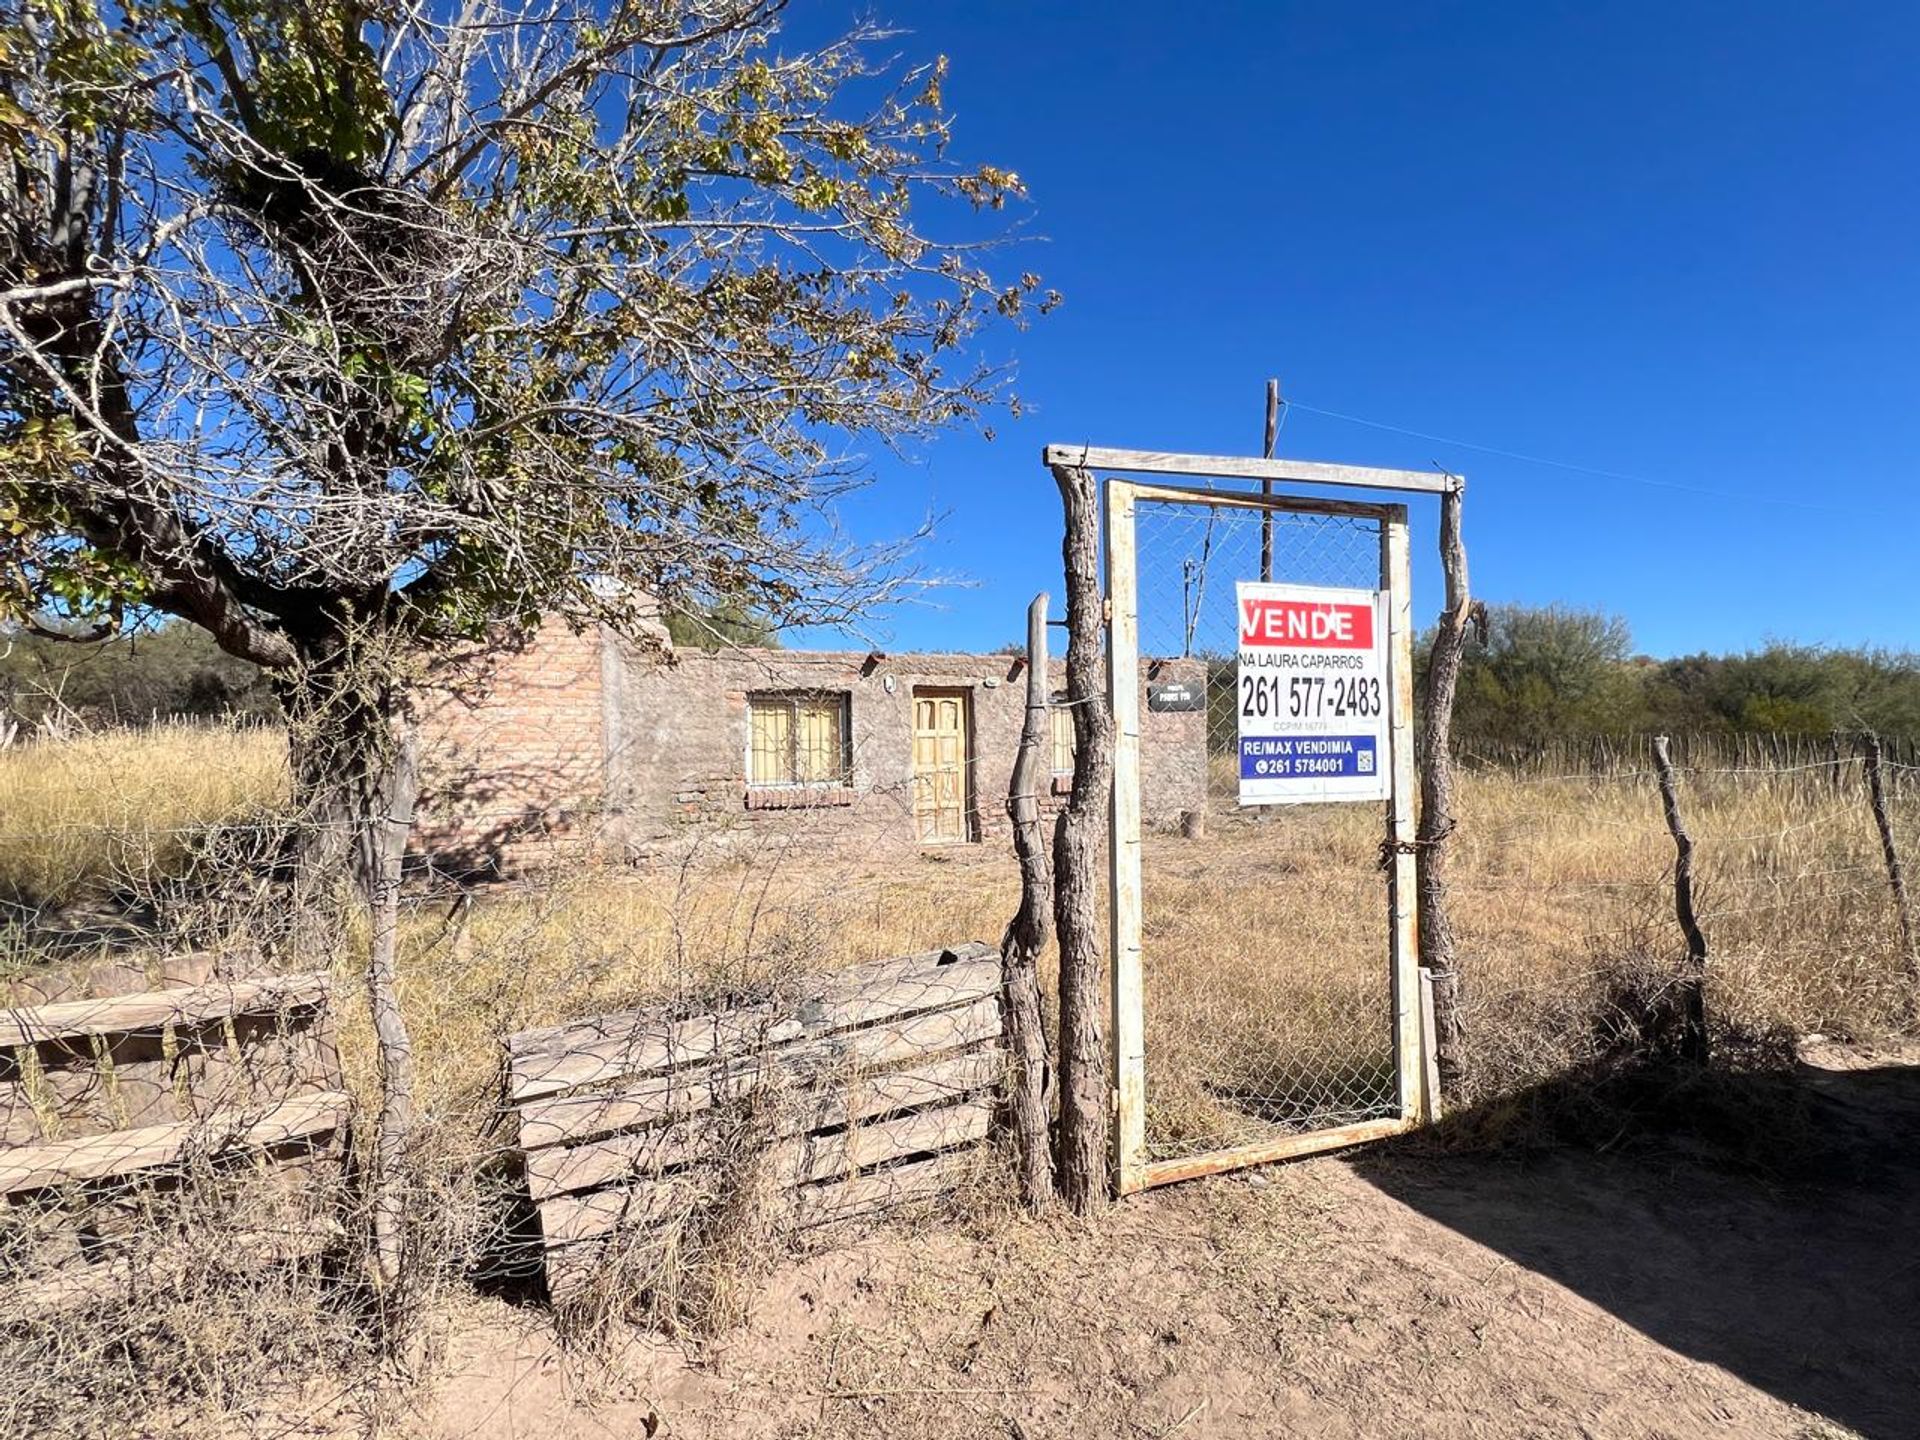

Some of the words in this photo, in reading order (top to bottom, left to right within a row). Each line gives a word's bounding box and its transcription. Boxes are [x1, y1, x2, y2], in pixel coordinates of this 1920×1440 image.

[1241, 607, 1354, 640] VENDE
[1258, 653, 1299, 668] LAURA
[1301, 654, 1363, 670] CAPARROS
[1242, 675, 1279, 717] 261
[1290, 676, 1381, 717] 577-2483
[1243, 741, 1292, 755] RE/MAX
[1295, 740, 1353, 754] VENDIMIA
[1269, 759, 1290, 773] 261
[1295, 758, 1343, 773] 5784001
